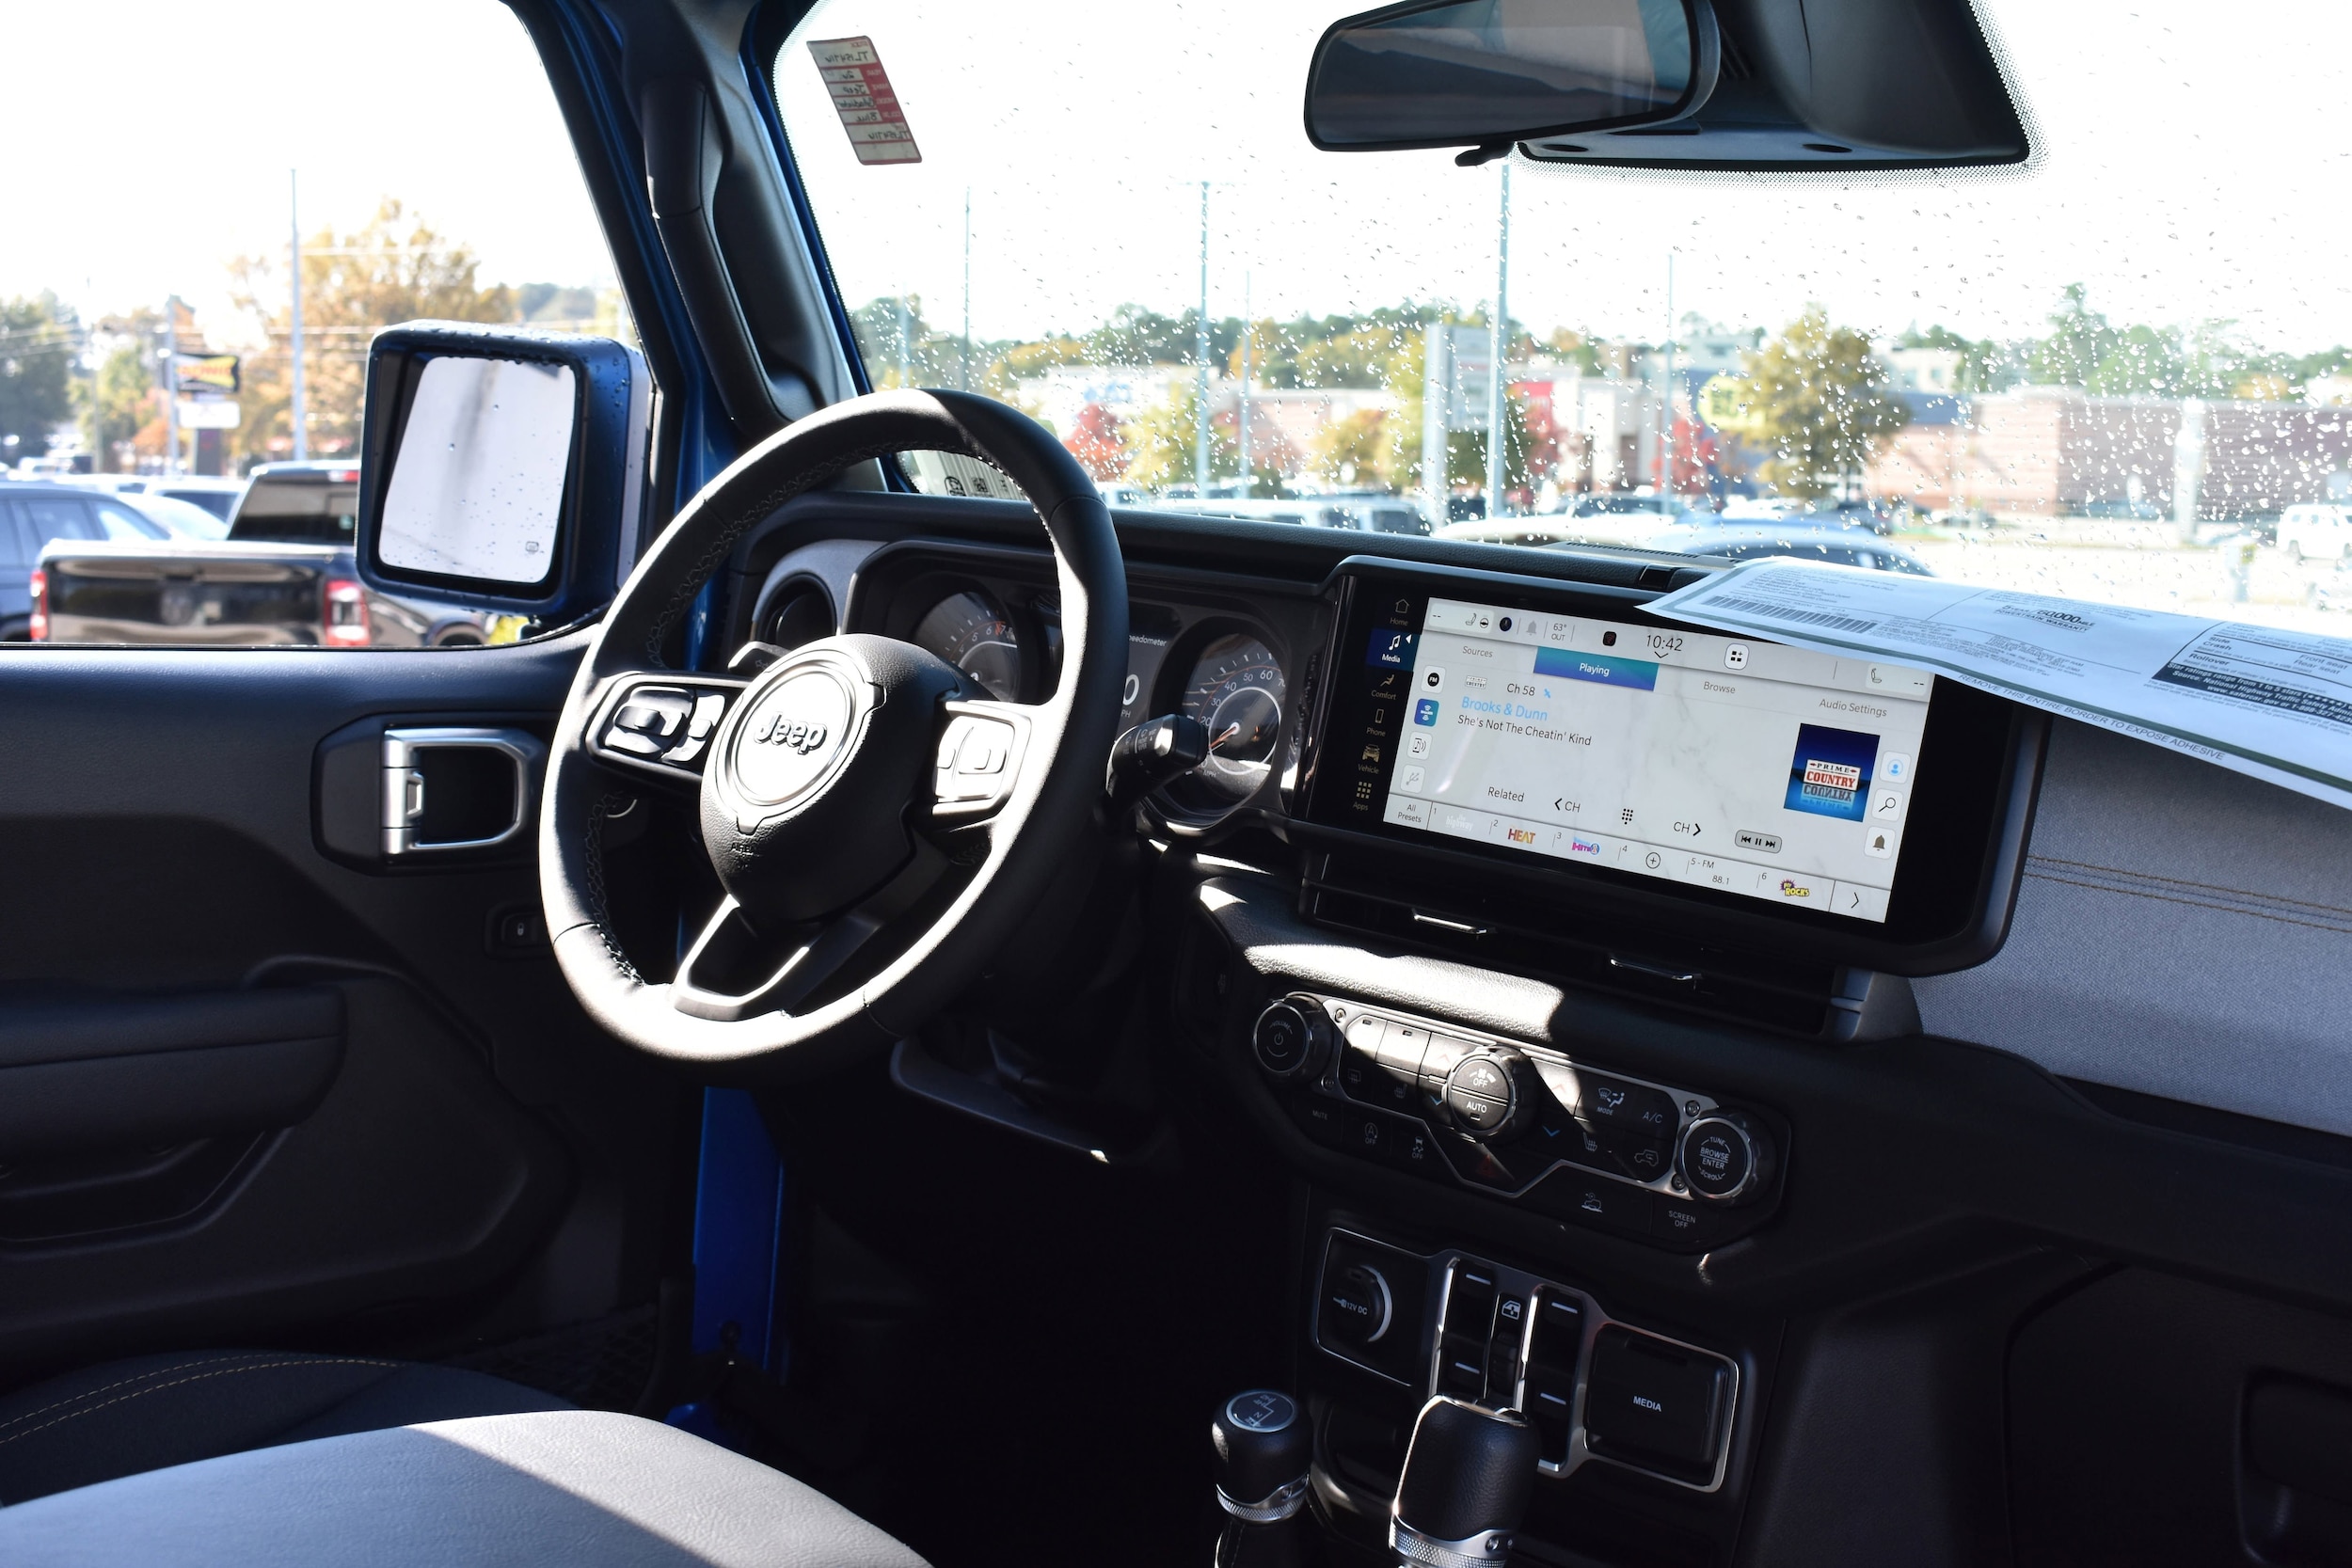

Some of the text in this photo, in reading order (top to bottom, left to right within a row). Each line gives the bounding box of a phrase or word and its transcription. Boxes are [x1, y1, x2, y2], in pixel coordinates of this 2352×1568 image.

[1390, 617, 1408, 626] Home
[985, 626, 993, 635] 6
[972, 632, 979, 641] 5
[1129, 634, 1168, 647] eedometer
[1551, 633, 1565, 641] OUT
[1646, 634, 1683, 652] 10:42
[1462, 645, 1493, 657] Sources
[1381, 653, 1401, 663] Media
[2189, 653, 2231, 666] Rollover
[1579, 662, 1610, 677] Playing
[1243, 673, 1253, 682] 50
[1260, 671, 1273, 680] 60
[1122, 673, 1140, 705] 0
[1224, 682, 1237, 691] 40
[1506, 683, 1535, 697] Ch 58
[1703, 681, 1736, 694] Browse
[1371, 689, 1397, 700] Comfort
[1211, 698, 1222, 707] 30
[1819, 698, 1887, 718] Audio Settings
[1461, 696, 1549, 721] Brooks & Dunn
[1200, 717, 1212, 727] 20
[1958, 673, 2226, 761] REMOVE THIS ENTIRE BORDER TO EXPOSE ADHESIVE
[753, 711, 828, 756] Jeep
[1366, 727, 1386, 737] Phone
[1457, 714, 1592, 746] She's Not The Cheatin' Kind
[1358, 764, 1380, 774] Vehicle
[1817, 763, 1850, 773] PRIME
[1806, 770, 1856, 788] COUNTRY
[1487, 786, 1525, 802] Related
[1352, 801, 1369, 812] Apps
[1406, 803, 1416, 812] All
[1565, 800, 1581, 813] CH
[1398, 812, 1422, 823] Presets
[1673, 821, 1690, 833] CH
[1508, 828, 1536, 845] HEAT
[1556, 832, 1563, 840] 3
[1702, 860, 1715, 869] FM
[1712, 875, 1730, 885] 88.1
[1761, 872, 1768, 880] 6
[1785, 887, 1810, 896] ROCKS
[1472, 1078, 1488, 1088] OFF
[1466, 1101, 1487, 1114] AUTO
[1597, 1106, 1613, 1116] MODE
[1312, 1110, 1327, 1120] MUTE
[1642, 1111, 1663, 1124] A/C
[1364, 1136, 1376, 1146] OFF
[1709, 1136, 1726, 1147] TUNE
[1411, 1151, 1423, 1160] OFF
[1700, 1146, 1729, 1161] BROWSE
[1702, 1157, 1725, 1170] ENTER
[1668, 1210, 1696, 1224] SCREEN
[1674, 1220, 1689, 1228] OFF
[1347, 1302, 1368, 1315] 12V DC
[1632, 1395, 1662, 1412] MEDIA
